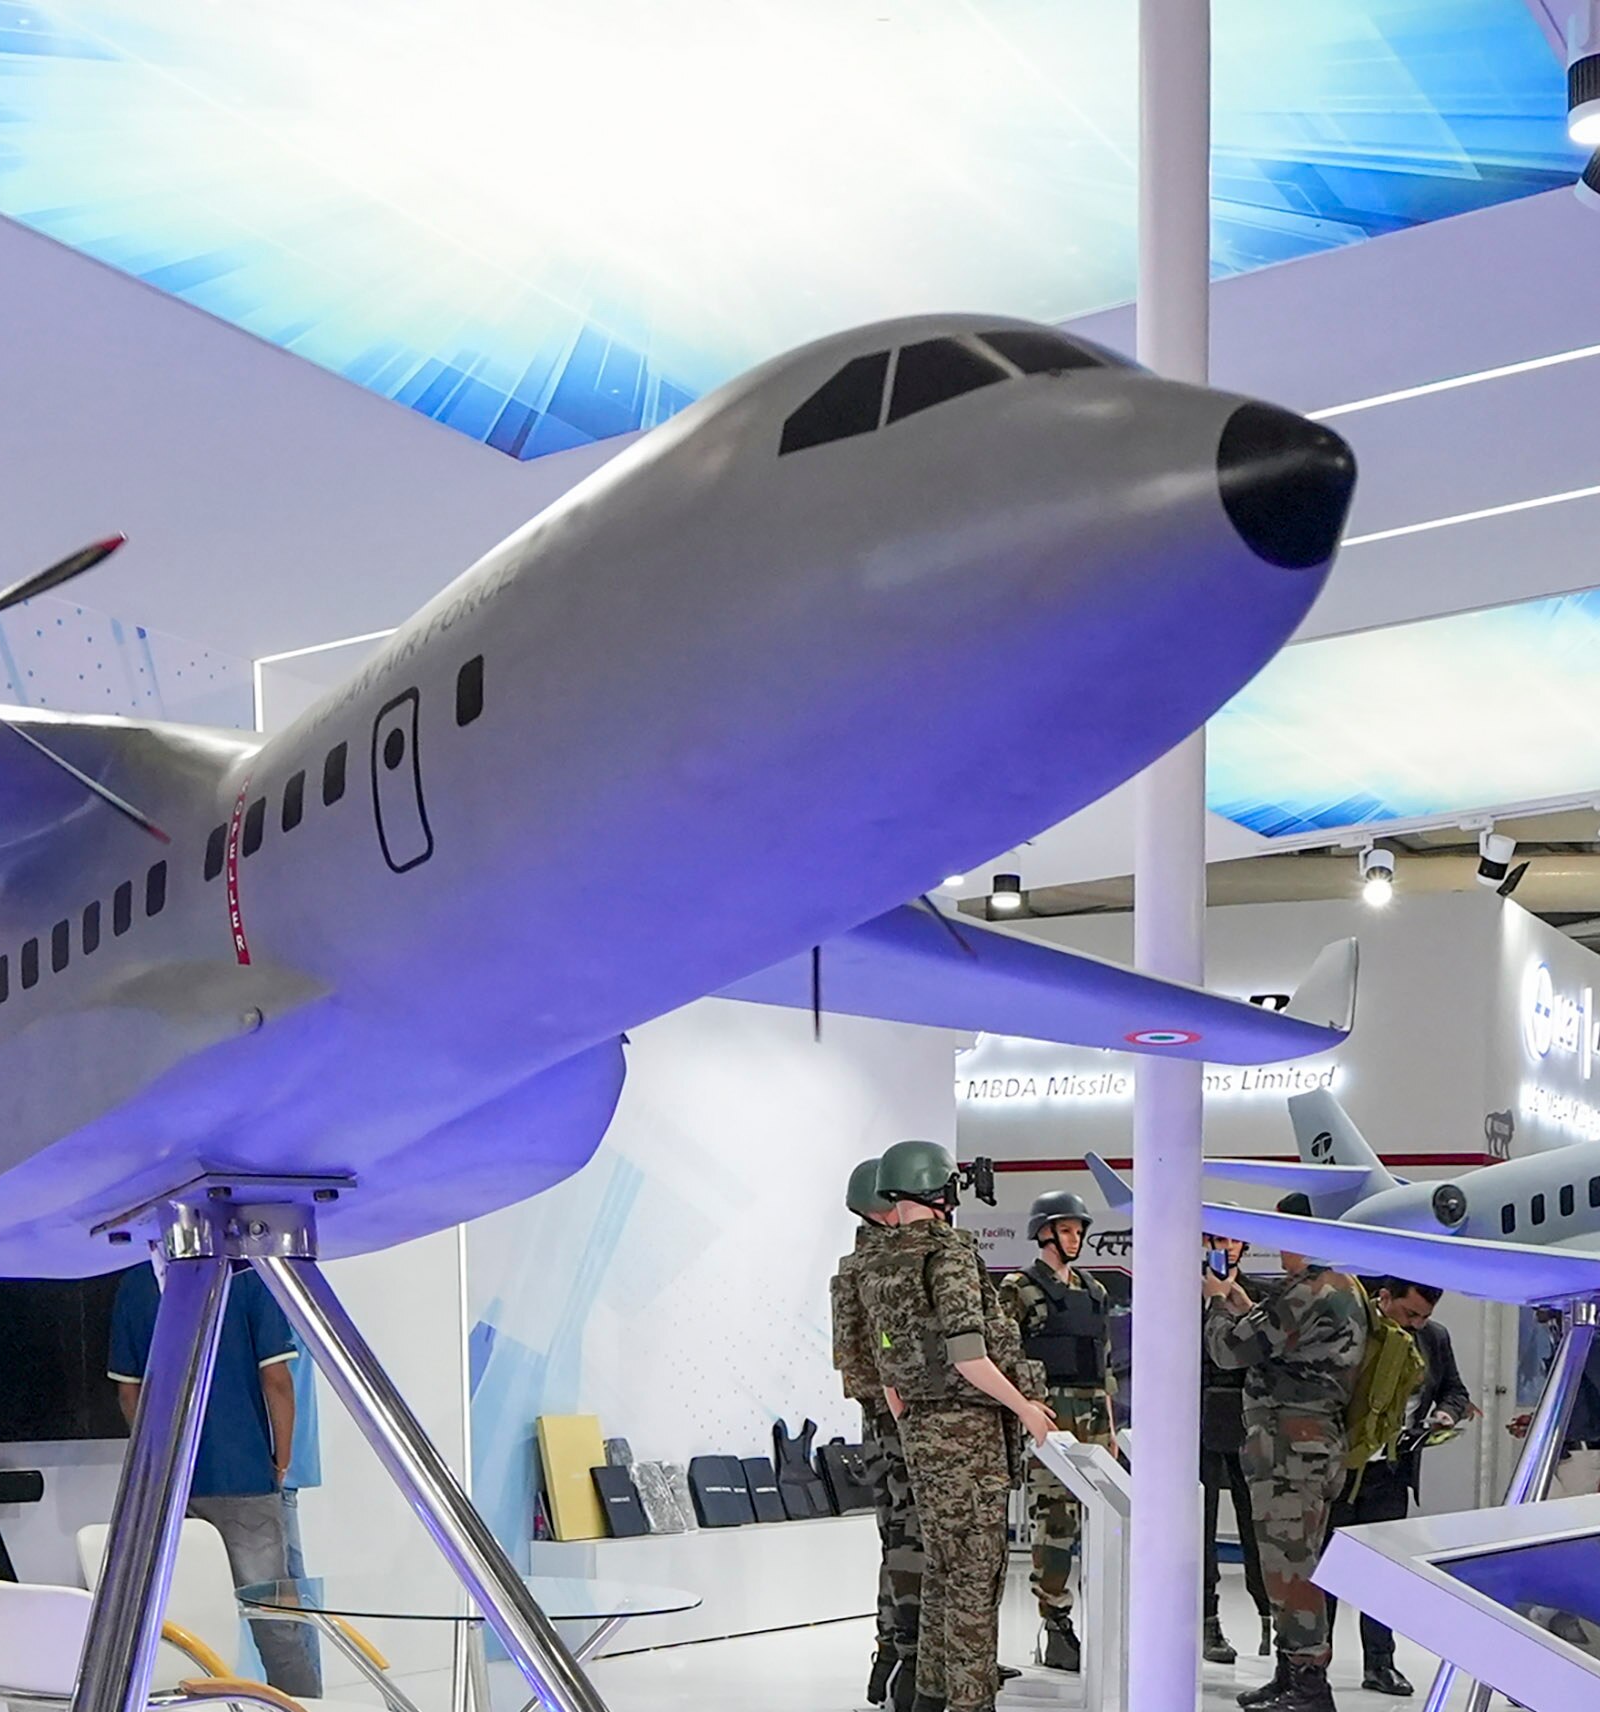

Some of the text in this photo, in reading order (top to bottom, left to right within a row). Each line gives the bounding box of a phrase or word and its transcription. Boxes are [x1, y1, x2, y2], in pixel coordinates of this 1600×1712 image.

[375, 630, 421, 682] AIR
[424, 559, 521, 643] FORCE
[967, 1078, 1037, 1100] MBDA
[1046, 1073, 1127, 1097] Missile
[1241, 1065, 1336, 1091] Limited
[982, 1228, 1016, 1240] Facility
